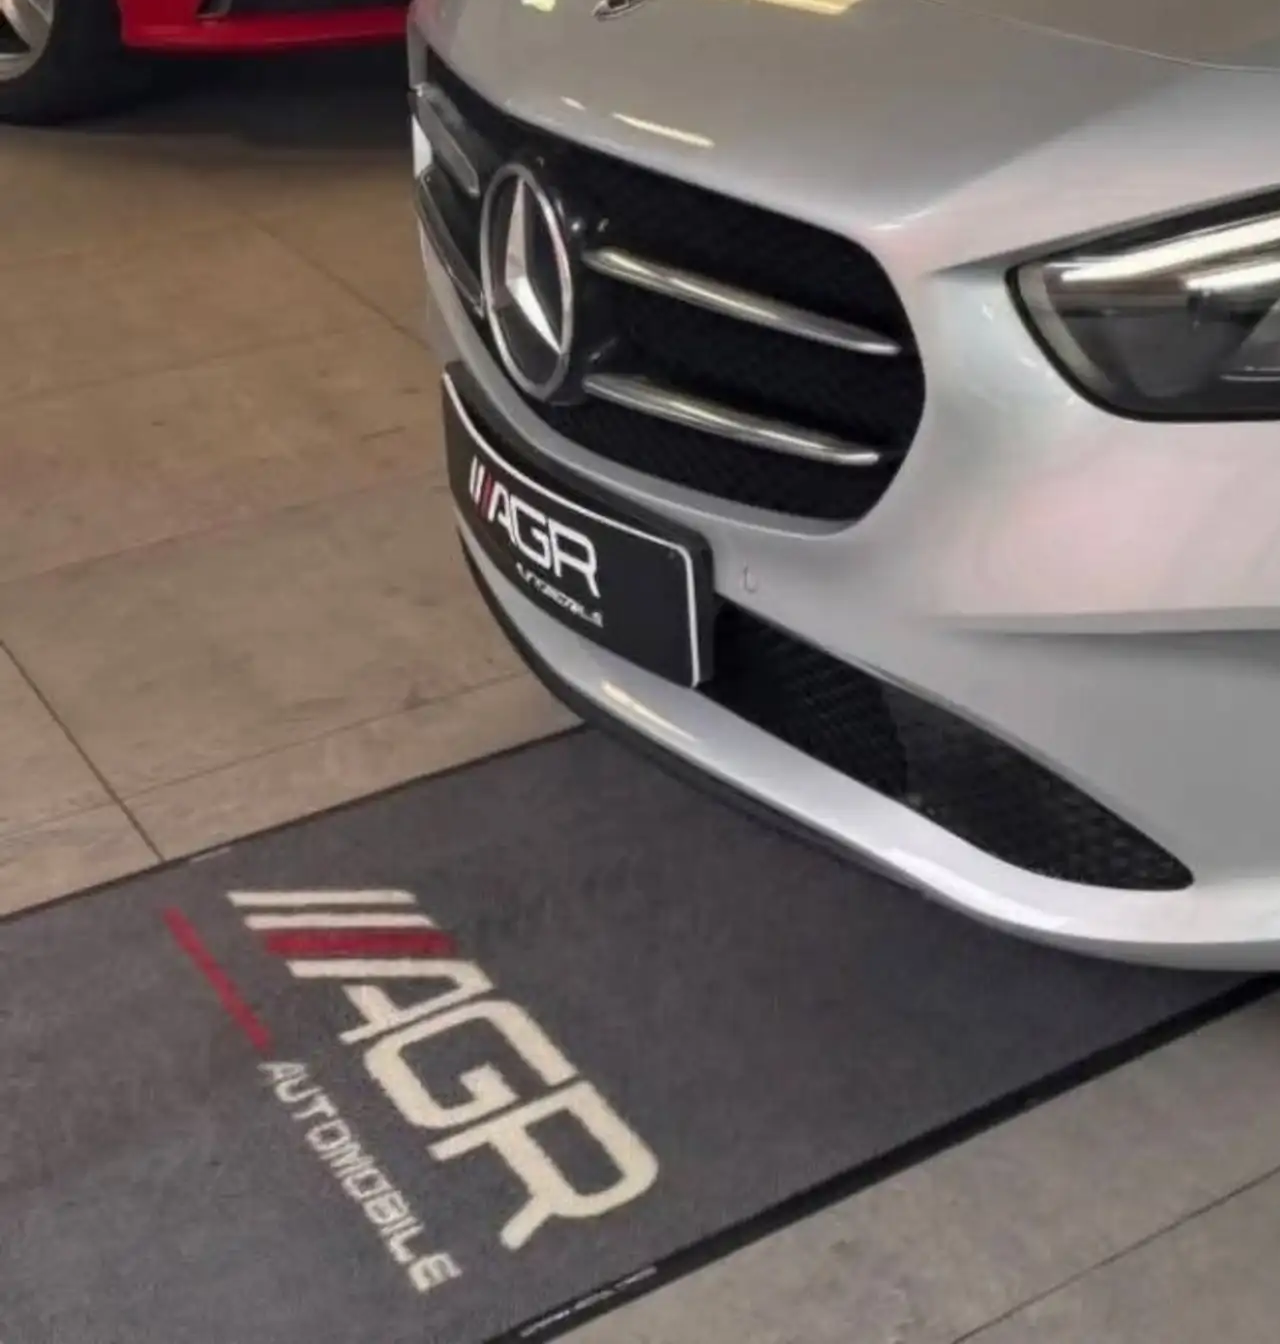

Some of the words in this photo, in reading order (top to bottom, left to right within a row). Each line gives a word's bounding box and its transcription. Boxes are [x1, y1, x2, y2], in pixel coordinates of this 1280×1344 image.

[488, 481, 600, 599] AGR
[258, 1061, 462, 1293] AUTOMOBILE
[287, 960, 658, 1250] AGR
